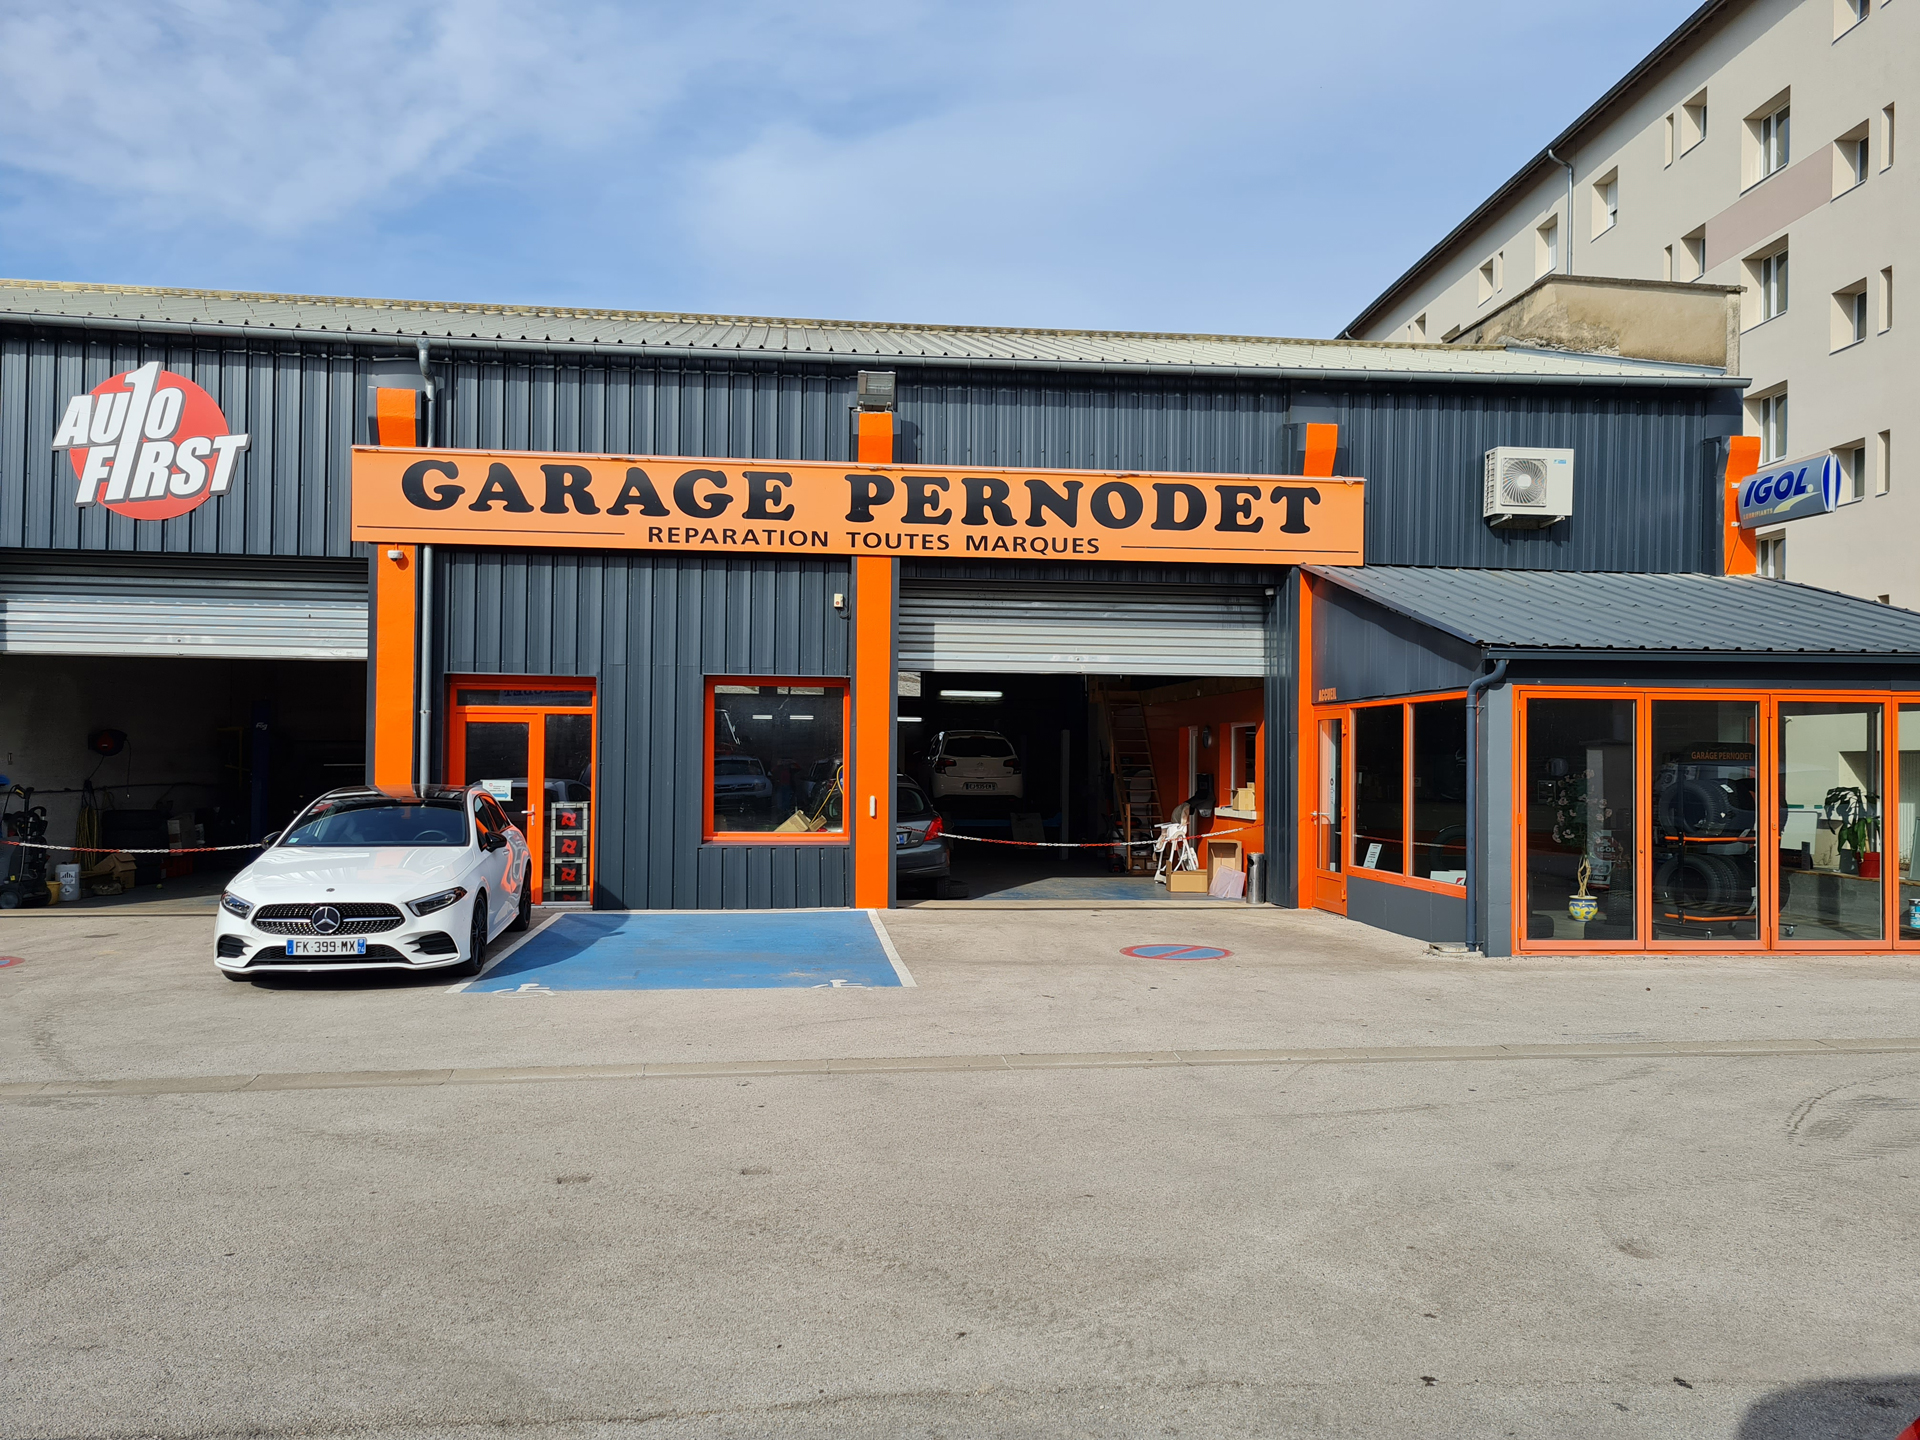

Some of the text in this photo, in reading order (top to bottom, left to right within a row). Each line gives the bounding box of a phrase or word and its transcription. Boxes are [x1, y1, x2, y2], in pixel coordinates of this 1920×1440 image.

[75, 433, 250, 504] FIRST
[1743, 466, 1809, 508] IGOL
[401, 460, 1321, 534] GARAGE PERNODET
[648, 526, 1100, 556] REPARATION TOUTES MARQUES
[1691, 751, 1752, 760] GARAGE PERNODET
